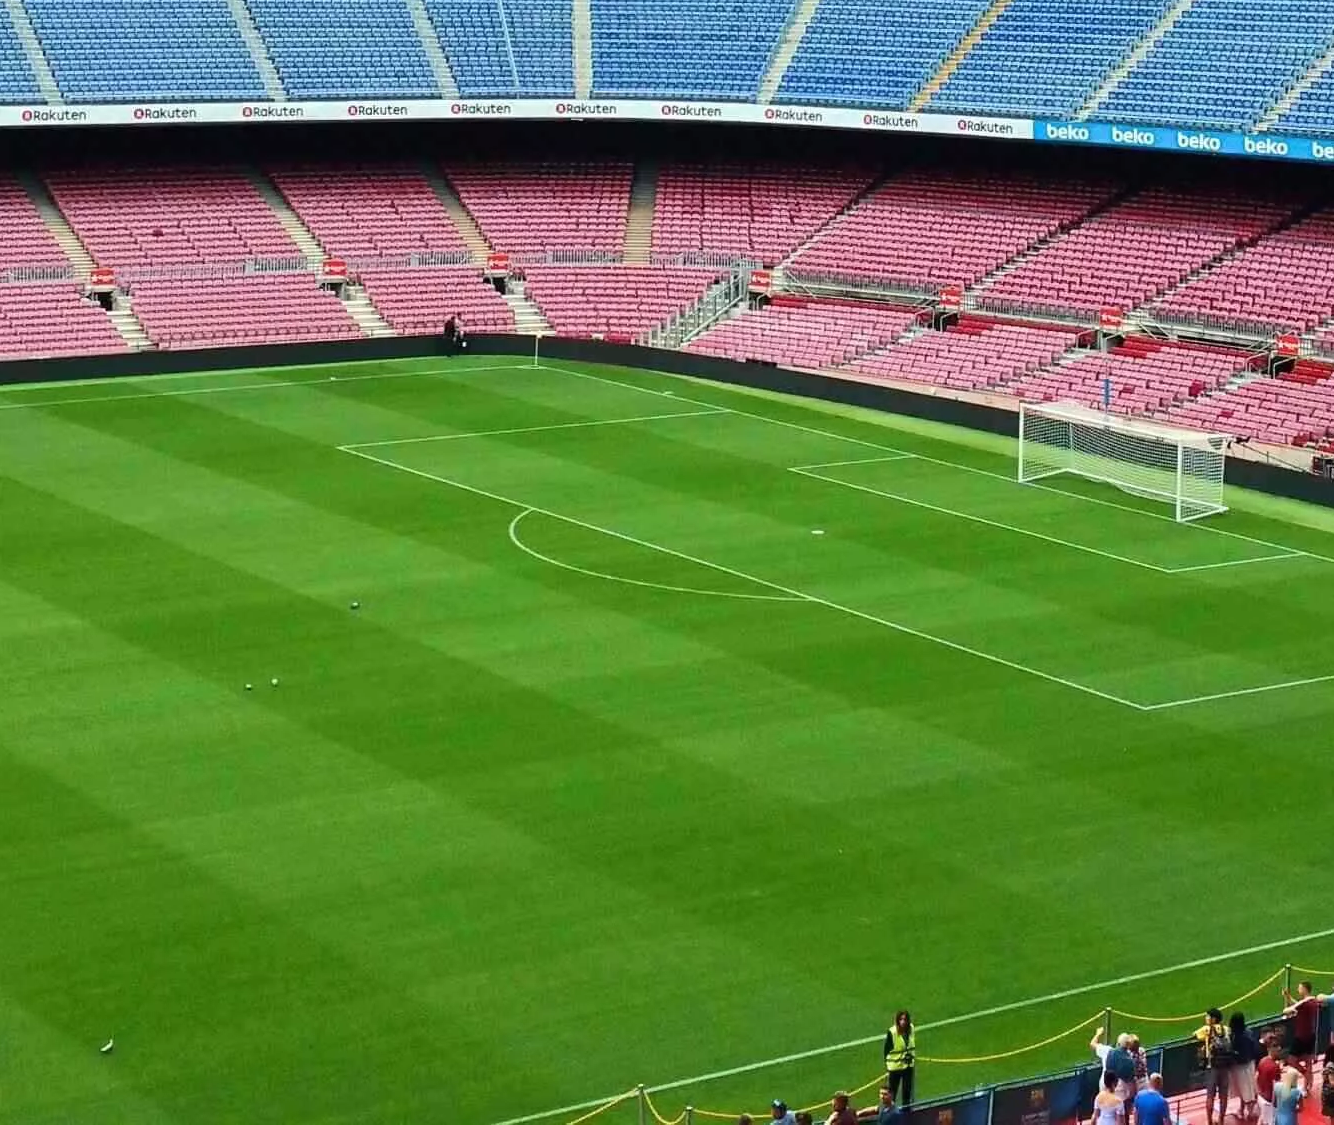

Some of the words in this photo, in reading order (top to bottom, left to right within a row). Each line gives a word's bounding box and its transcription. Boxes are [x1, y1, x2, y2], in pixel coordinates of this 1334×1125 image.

[144, 108, 197, 119] Rakuten
[252, 107, 304, 118] Rakuten
[357, 105, 408, 116] Rakuten
[460, 103, 512, 115] Rakuten
[565, 103, 617, 115] Rakuten
[671, 106, 722, 117] Rakuten
[33, 110, 87, 122] Rakuten
[774, 110, 823, 122] Rakuten
[872, 115, 918, 128] Rakuten
[966, 120, 1013, 134] Rakuten
[1047, 124, 1088, 140] beko
[1113, 127, 1154, 144] beko
[1178, 132, 1220, 151] beko
[1245, 137, 1287, 155] beko
